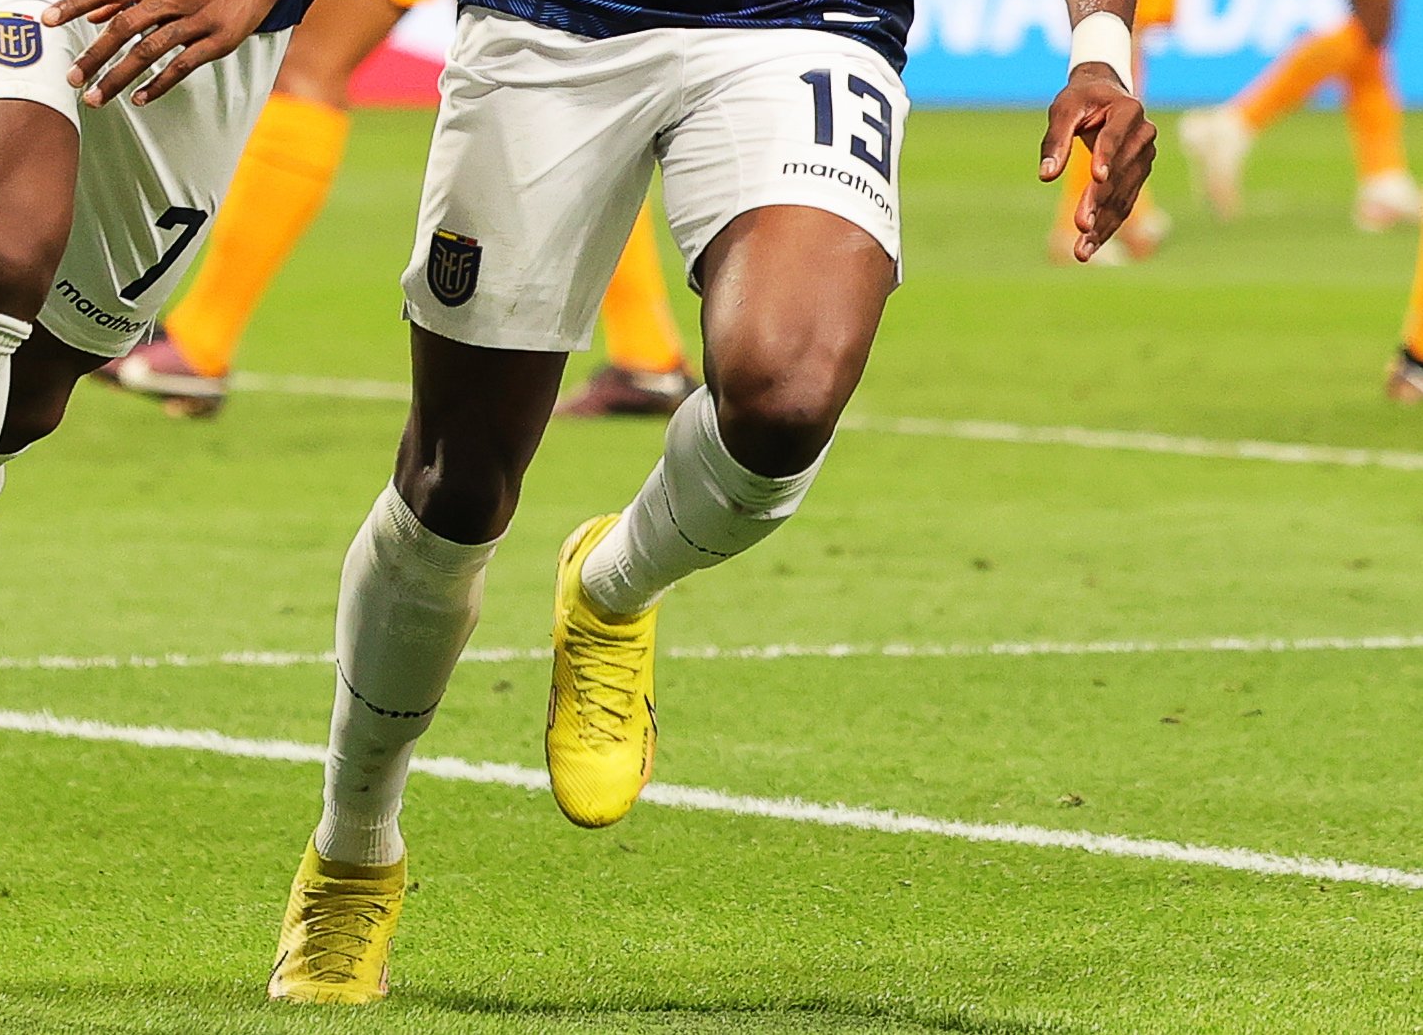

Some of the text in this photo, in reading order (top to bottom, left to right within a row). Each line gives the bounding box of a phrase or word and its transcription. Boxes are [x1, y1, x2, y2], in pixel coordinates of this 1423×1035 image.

[799, 68, 893, 185] 13
[782, 162, 893, 221] marathon
[119, 206, 209, 301] 7
